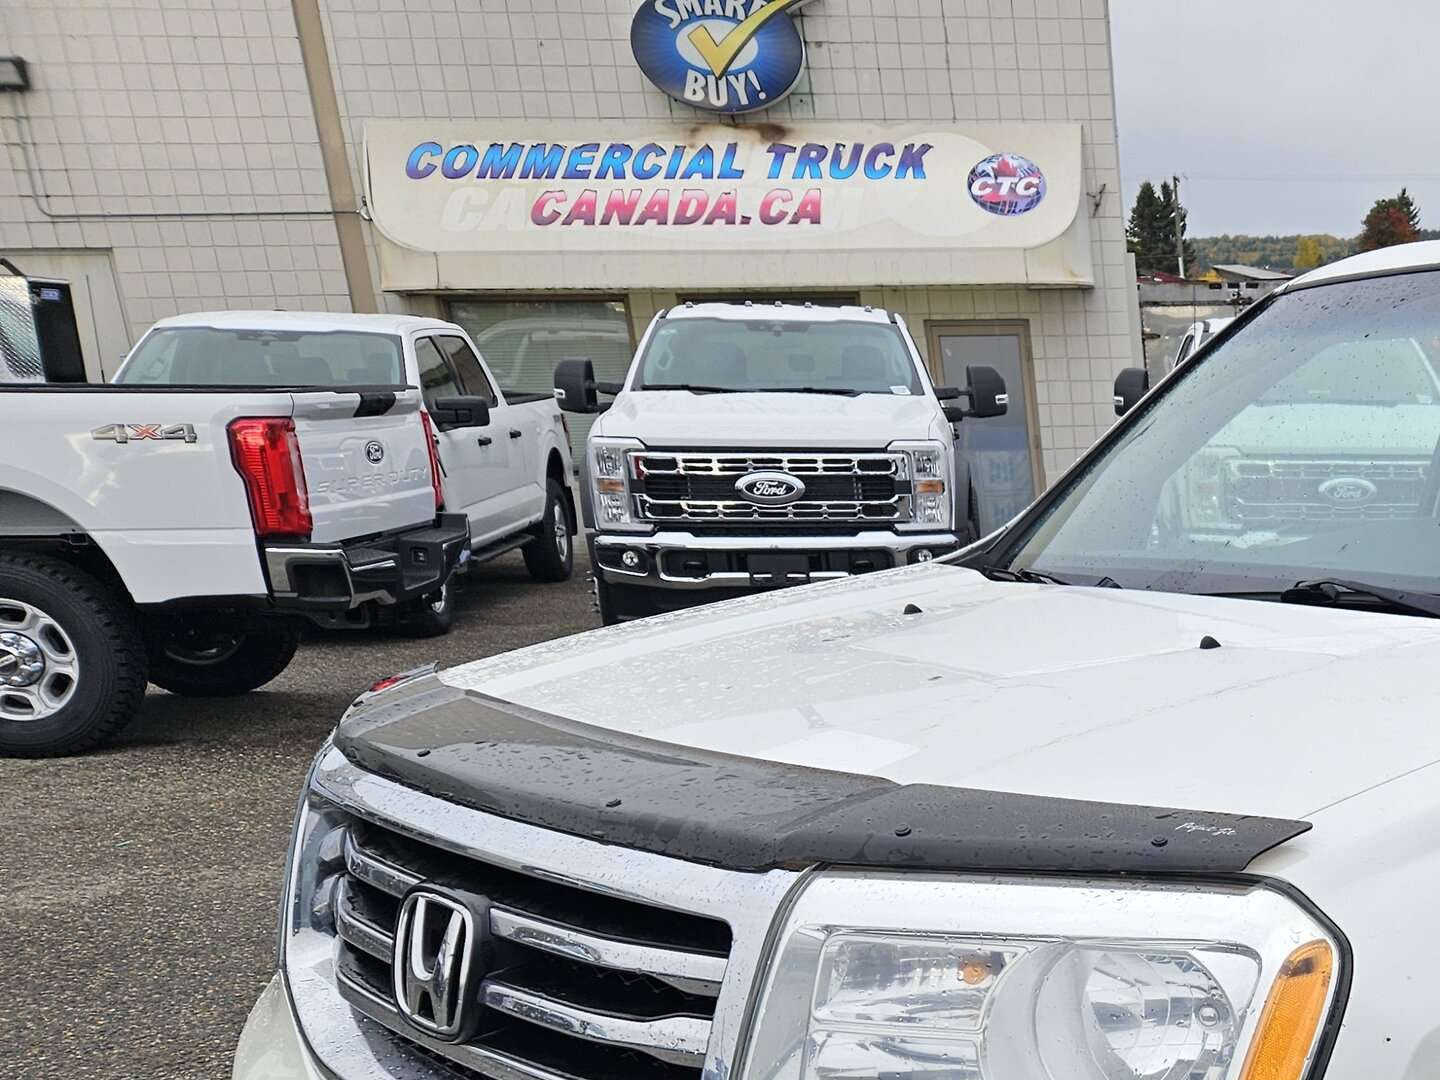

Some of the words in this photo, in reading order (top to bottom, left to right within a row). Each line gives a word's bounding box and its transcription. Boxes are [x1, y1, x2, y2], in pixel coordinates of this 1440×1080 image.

[655, 0, 768, 29] SMAR
[683, 69, 767, 107] BUY!
[405, 141, 744, 180] COMMERCIAL
[765, 141, 934, 180] TRUCK
[970, 176, 1041, 196] CTC
[530, 187, 823, 226] CANADA.CA
[316, 474, 386, 494] SUPER
[387, 466, 428, 486] DUTY
[753, 481, 787, 495] Ford
